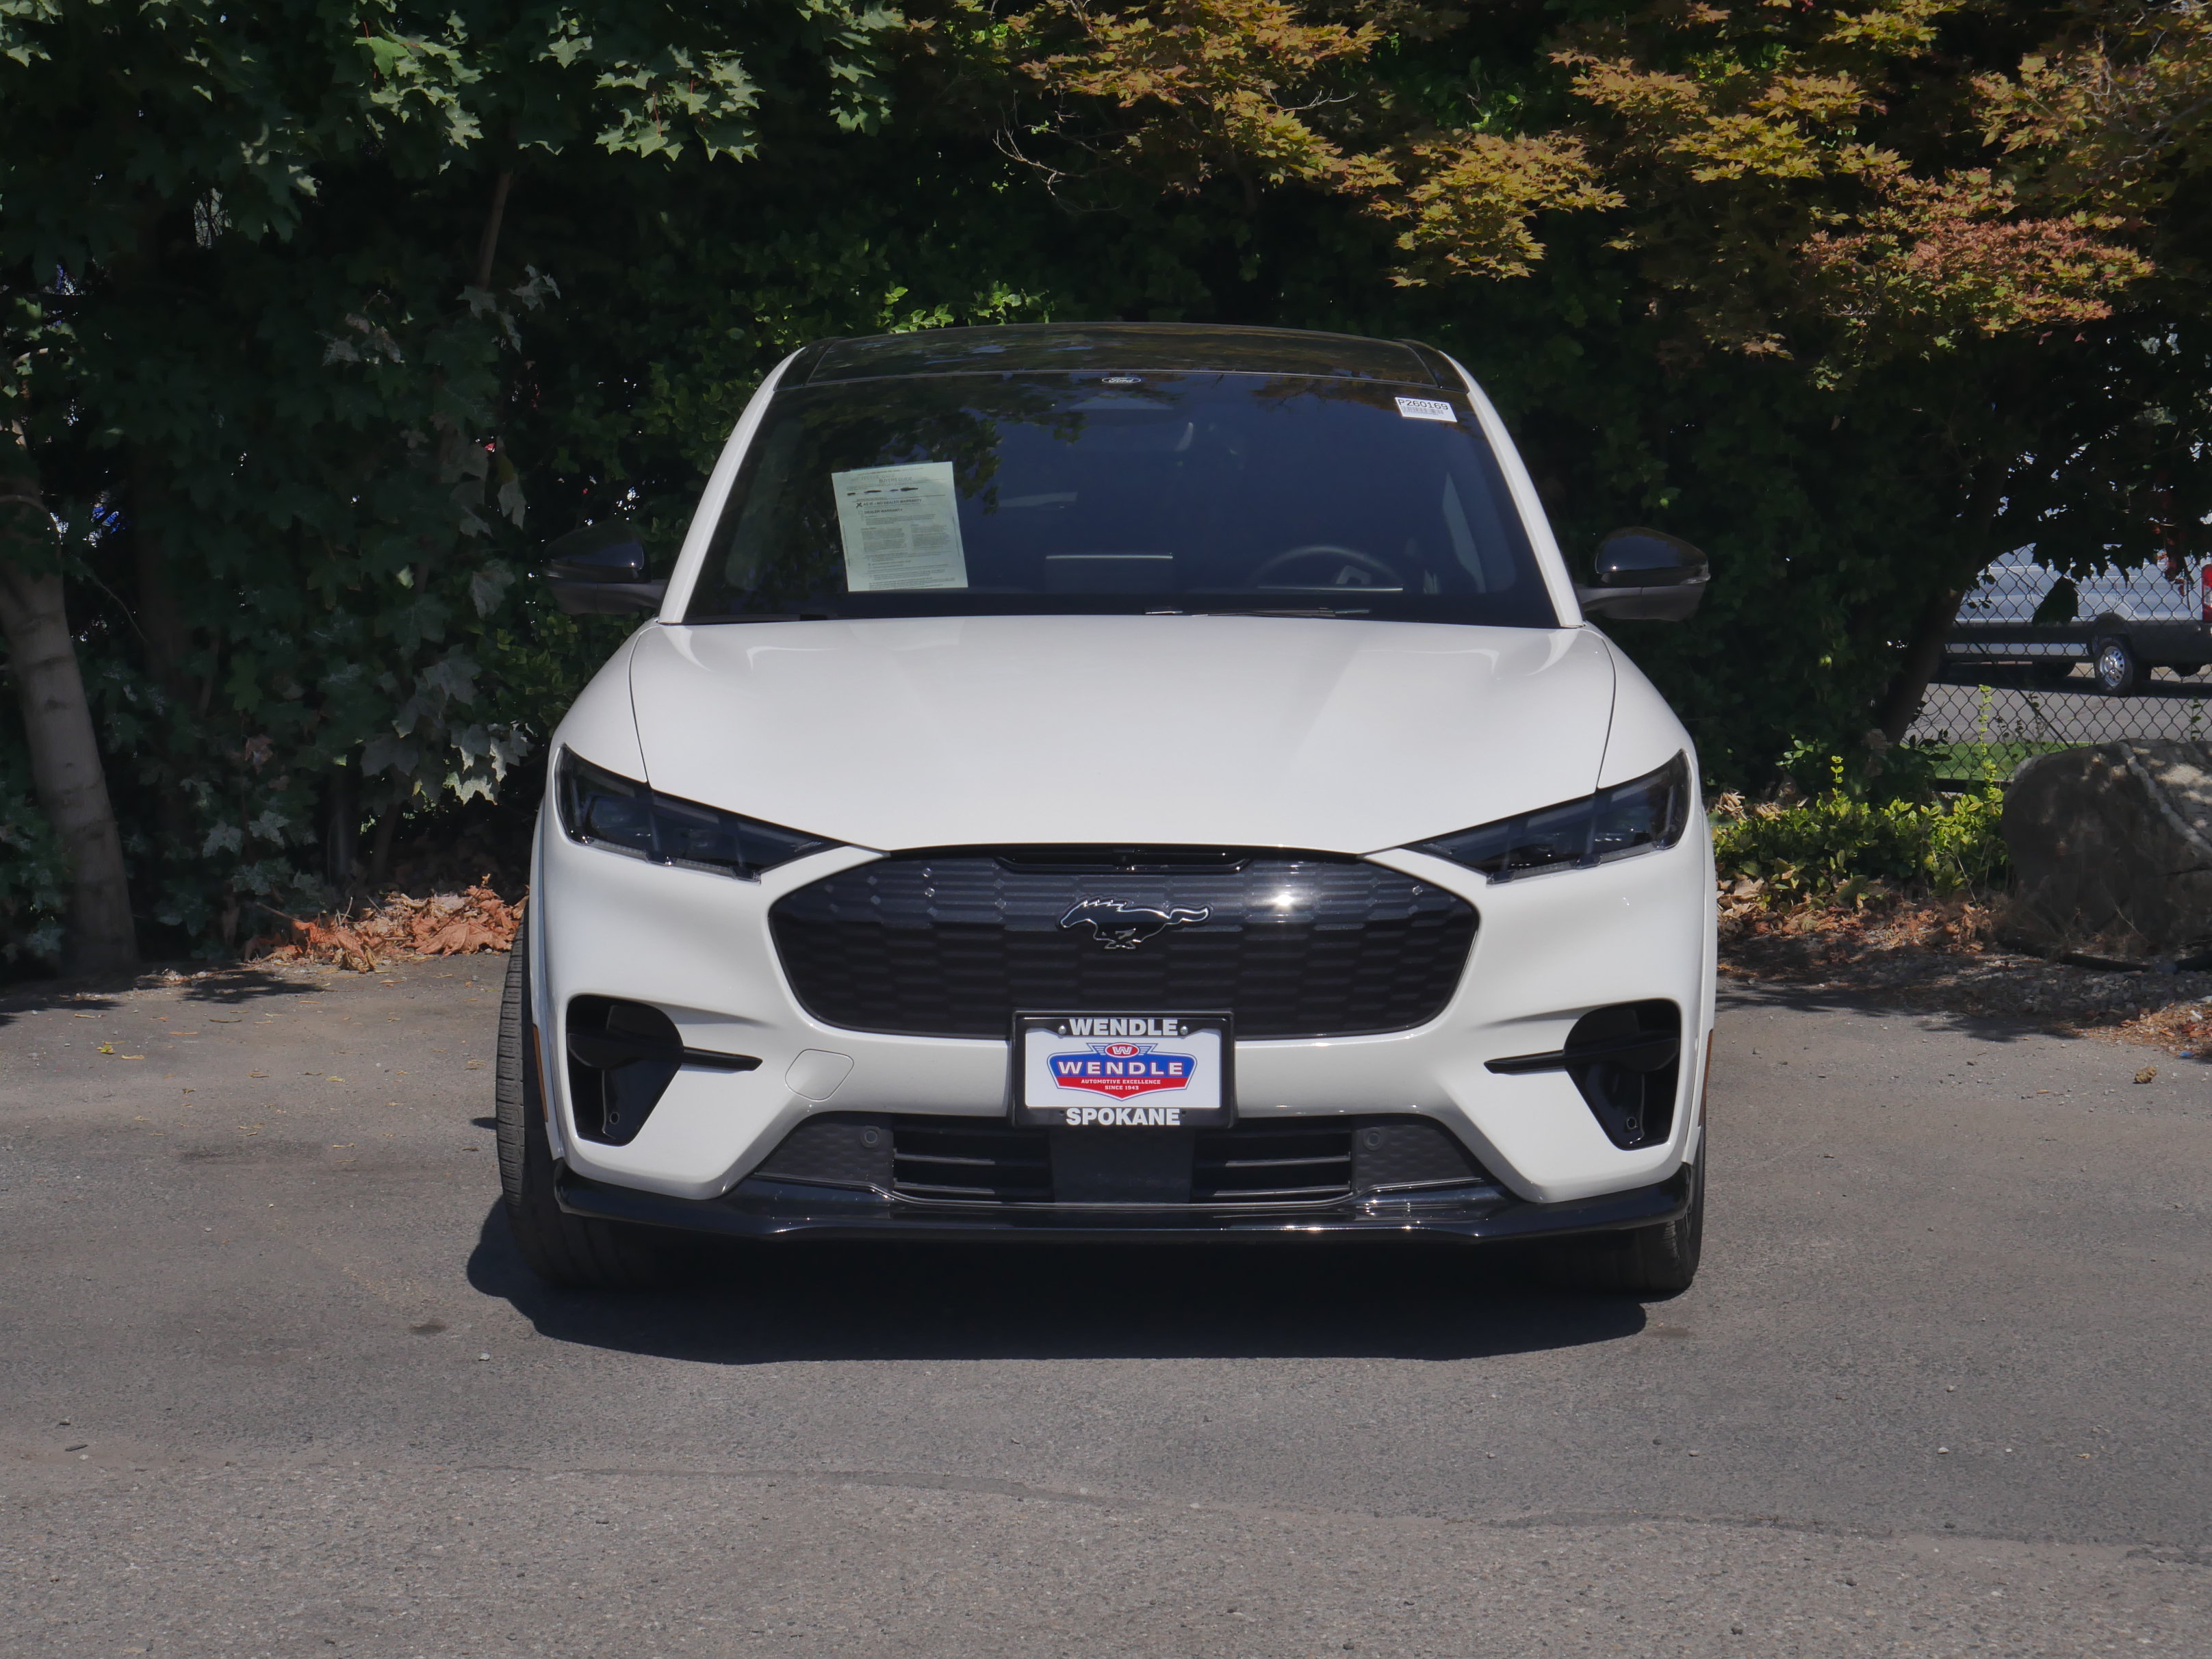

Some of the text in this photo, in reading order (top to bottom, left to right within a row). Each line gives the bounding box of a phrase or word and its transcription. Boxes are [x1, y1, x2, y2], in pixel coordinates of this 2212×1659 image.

[1398, 399, 1448, 410] P260169
[1069, 1018, 1179, 1036] WENDLE
[1112, 1046, 1133, 1055] W
[1058, 1061, 1183, 1075] WENDLE
[1066, 1107, 1181, 1126] SPOKANE
